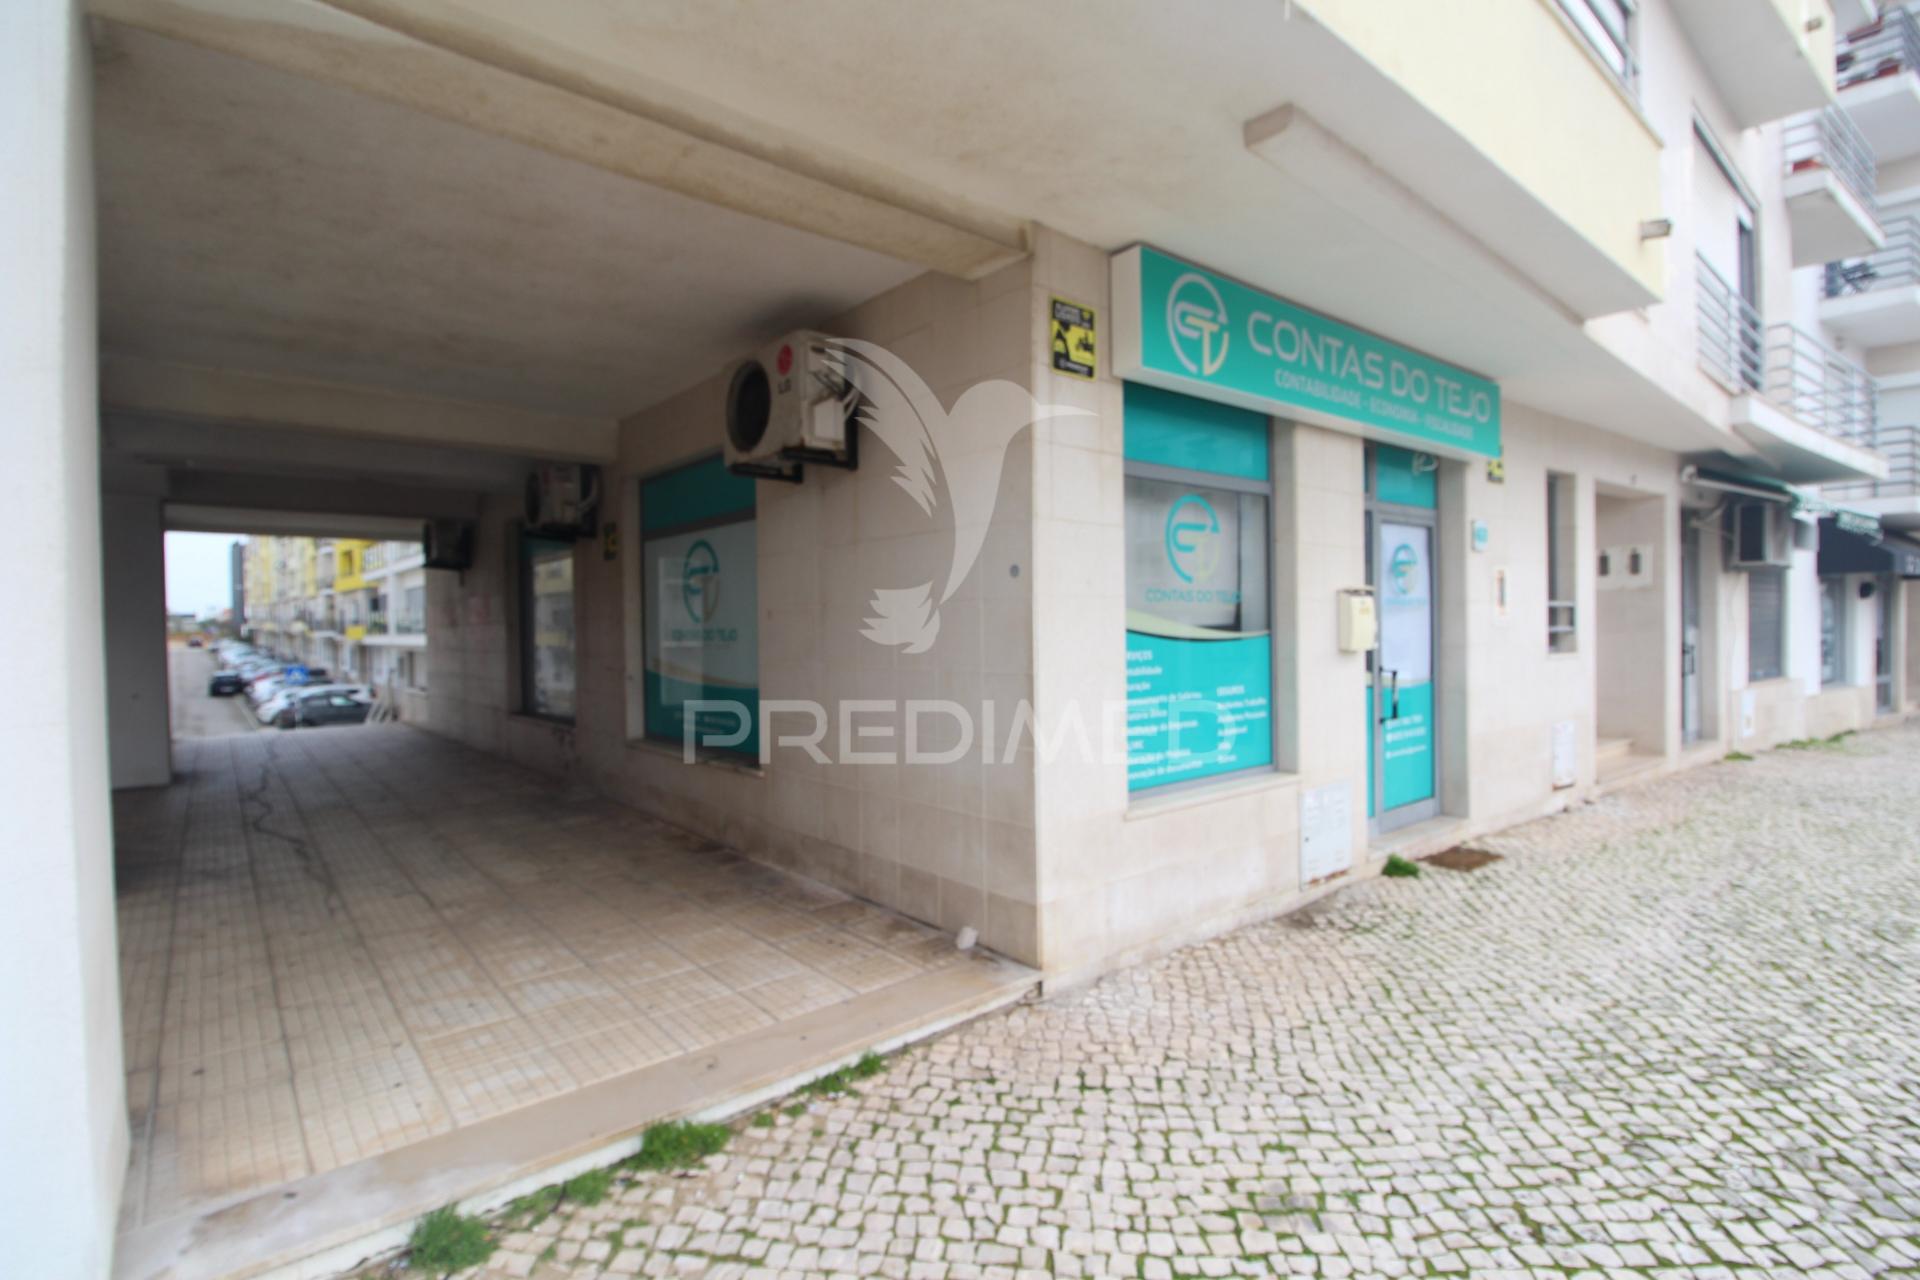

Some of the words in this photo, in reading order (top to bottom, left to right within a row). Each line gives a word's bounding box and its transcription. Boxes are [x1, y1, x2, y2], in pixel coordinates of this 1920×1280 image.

[1247, 310, 1384, 389] CONTAS
[1390, 361, 1430, 403] DO
[1434, 375, 1491, 424] TEJO
